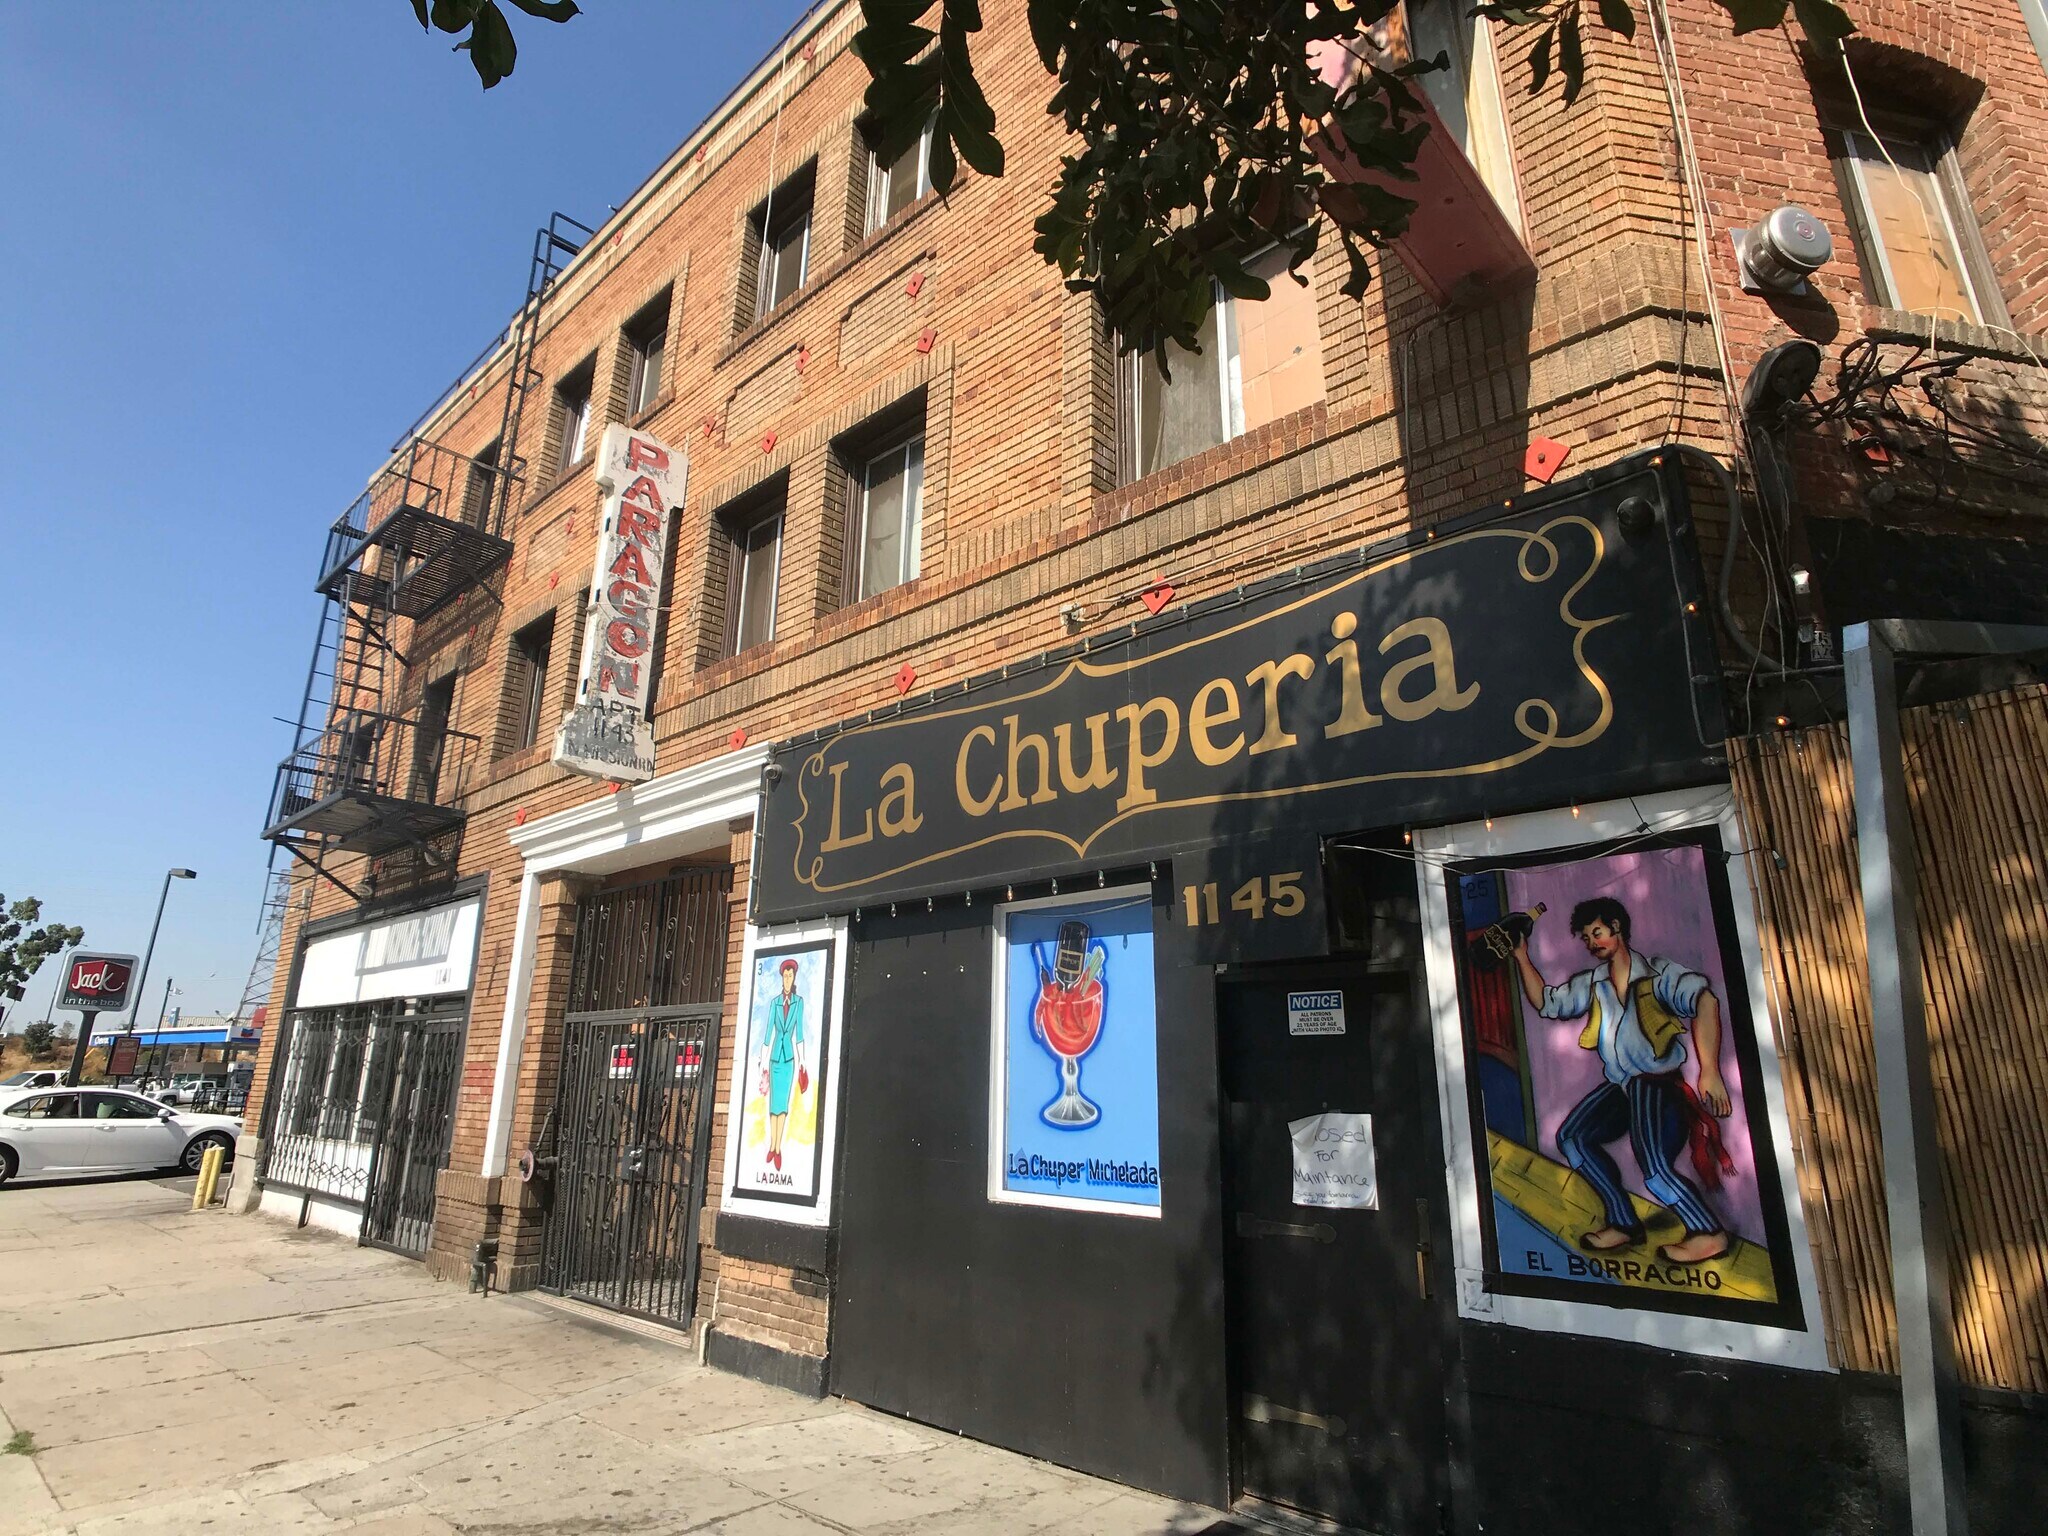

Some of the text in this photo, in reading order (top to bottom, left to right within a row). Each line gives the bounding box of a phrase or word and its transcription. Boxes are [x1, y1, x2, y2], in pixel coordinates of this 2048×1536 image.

[599, 436, 670, 700] PARAGON
[590, 698, 641, 725] APT
[820, 611, 1482, 853] La Chuperia
[1182, 871, 1306, 927] 1145
[1466, 881, 1489, 899] 25
[71, 963, 125, 992] Jack
[757, 962, 763, 976] 3
[65, 997, 122, 1007] in the box
[1291, 995, 1339, 1009] NOTICE
[755, 1171, 794, 1187] LA DAMA
[1009, 1153, 1159, 1186] La Chuper Michelada
[1526, 1250, 1723, 1291] EL BORRACHO
